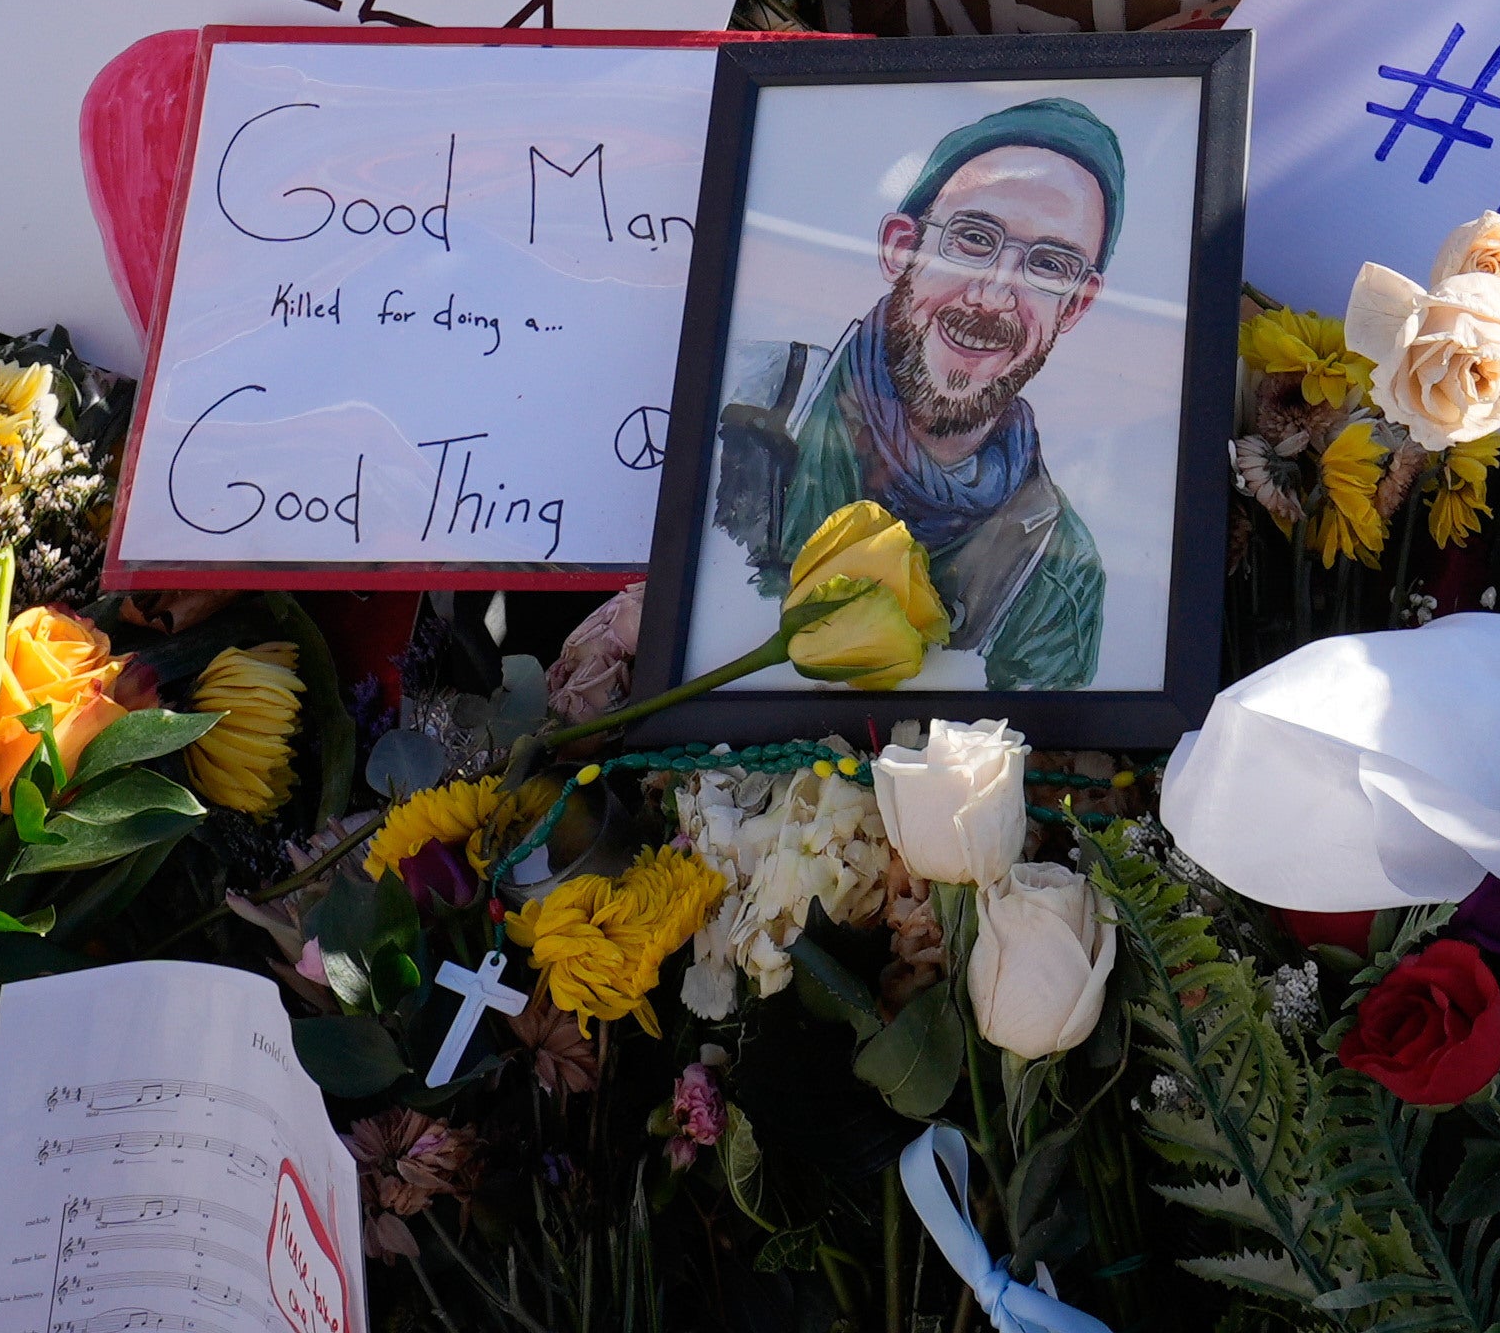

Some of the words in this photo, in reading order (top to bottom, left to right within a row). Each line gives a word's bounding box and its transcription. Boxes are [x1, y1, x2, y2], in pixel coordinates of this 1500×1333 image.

[212, 101, 457, 254] Good
[526, 142, 698, 262] Man
[270, 283, 344, 331] Killed
[376, 291, 422, 335] for
[430, 299, 508, 360] doing
[166, 383, 367, 545] Good
[417, 428, 566, 561] Thing
[251, 1031, 282, 1060] Hold
